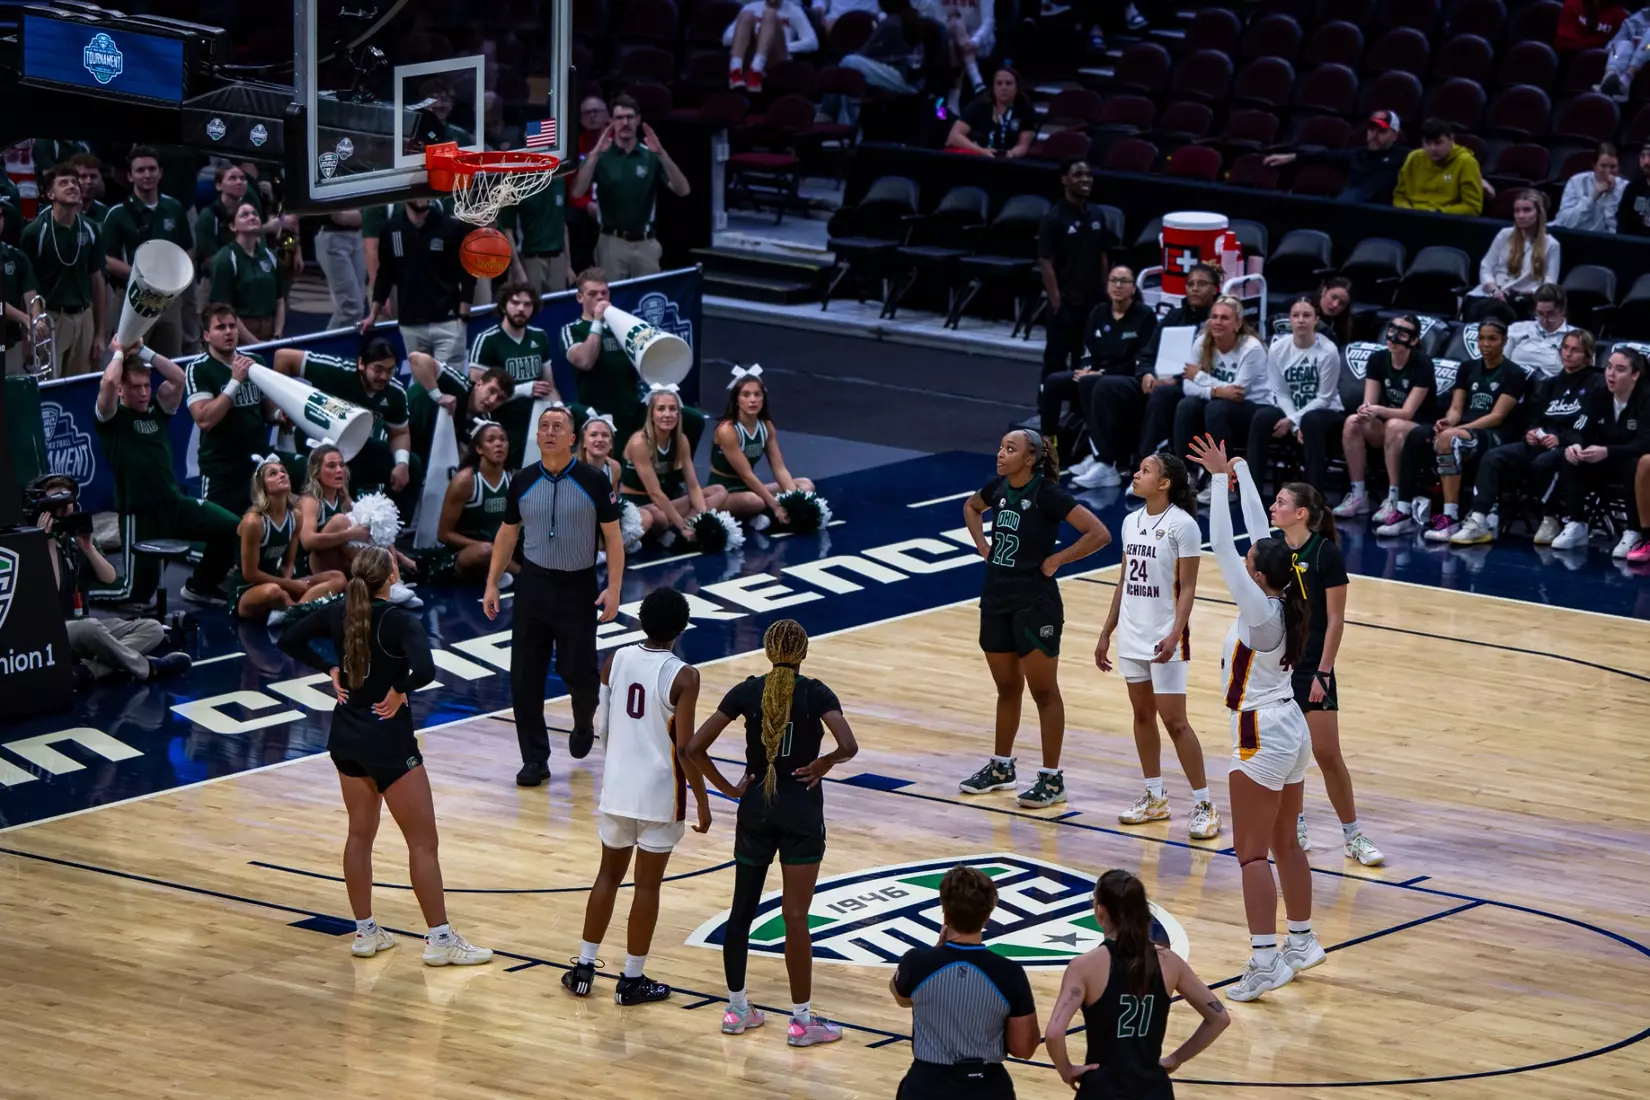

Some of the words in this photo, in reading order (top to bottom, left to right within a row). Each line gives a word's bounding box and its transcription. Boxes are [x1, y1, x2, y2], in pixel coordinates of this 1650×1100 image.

[505, 354, 542, 381] OHIO
[996, 509, 1020, 531] OHIO
[1126, 543, 1157, 559] CENTRAL
[1129, 558, 1149, 583] 24
[626, 682, 646, 720] 0
[826, 886, 910, 915] 1946
[1116, 994, 1154, 1039] 21
